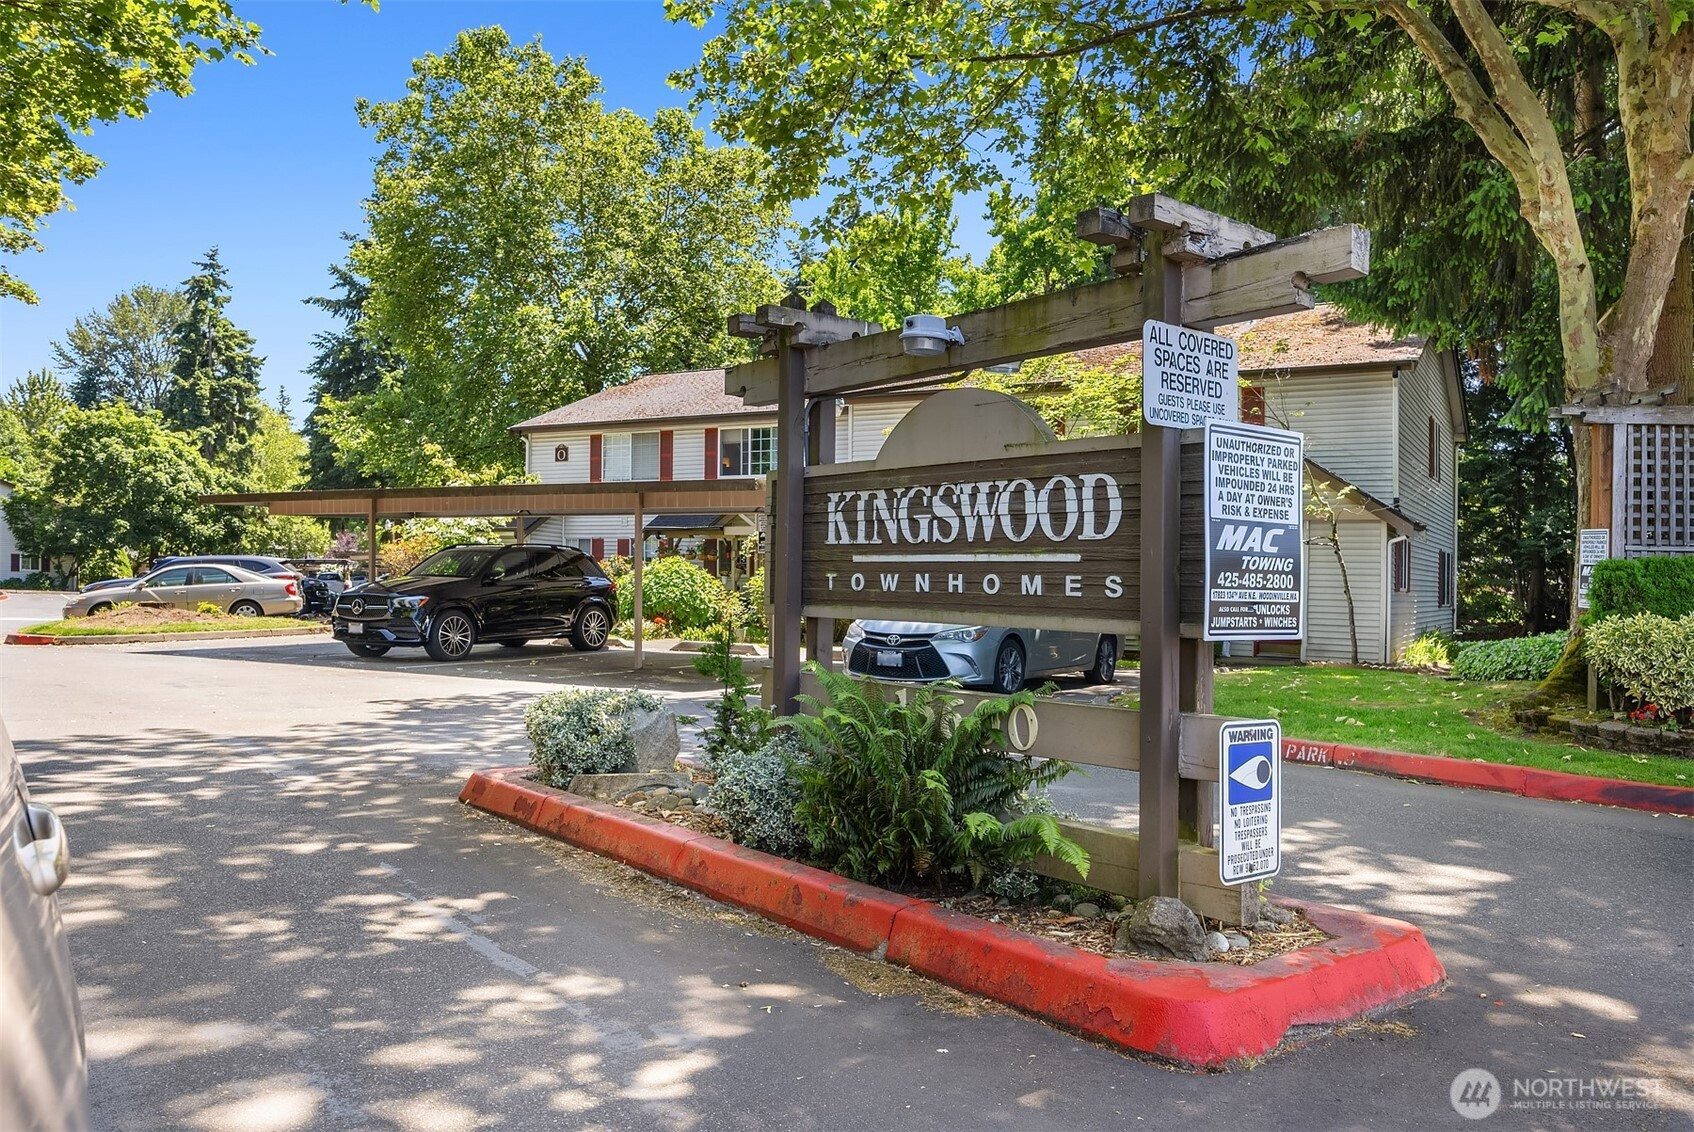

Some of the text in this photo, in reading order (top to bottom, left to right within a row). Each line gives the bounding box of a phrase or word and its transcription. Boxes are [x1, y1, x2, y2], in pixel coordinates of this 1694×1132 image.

[1149, 326, 1233, 360] ALL COVERED
[1154, 348, 1229, 380] SPACES ARE
[1161, 371, 1223, 399] RESERVED
[1158, 393, 1225, 415] GUESTS PLEASE USE
[1149, 406, 1189, 424] UNCOVERED
[1216, 437, 1295, 458] UNAUTHORIZED OR
[1211, 450, 1298, 472] IMPROPERLY PARKED
[1218, 463, 1293, 483] VEHICLES WILL BE
[1215, 476, 1295, 496] IMPOUNDED 24 HRS
[1217, 490, 1293, 508] A DAY AT OWNER'S
[823, 473, 1123, 545] KINGSWOOD
[1221, 504, 1289, 520] RISK & EXPENSE
[1216, 524, 1285, 553] MAC
[1241, 555, 1294, 572] TOWING
[824, 573, 1124, 599] TOWNHOMES
[1238, 591, 1248, 600] AVE
[1256, 604, 1290, 615] UNLOCKS
[1210, 616, 1297, 628] JUMPSTARTS WINCHES
[1228, 728, 1274, 743] WARNING
[1230, 802, 1271, 818] NO TRESPASSING
[1234, 814, 1268, 829] NO LOITERING
[1234, 826, 1268, 841] TRESPASSERS
[1241, 838, 1261, 851] WILL BE
[1227, 846, 1274, 866] PROSECUTED UNDER
